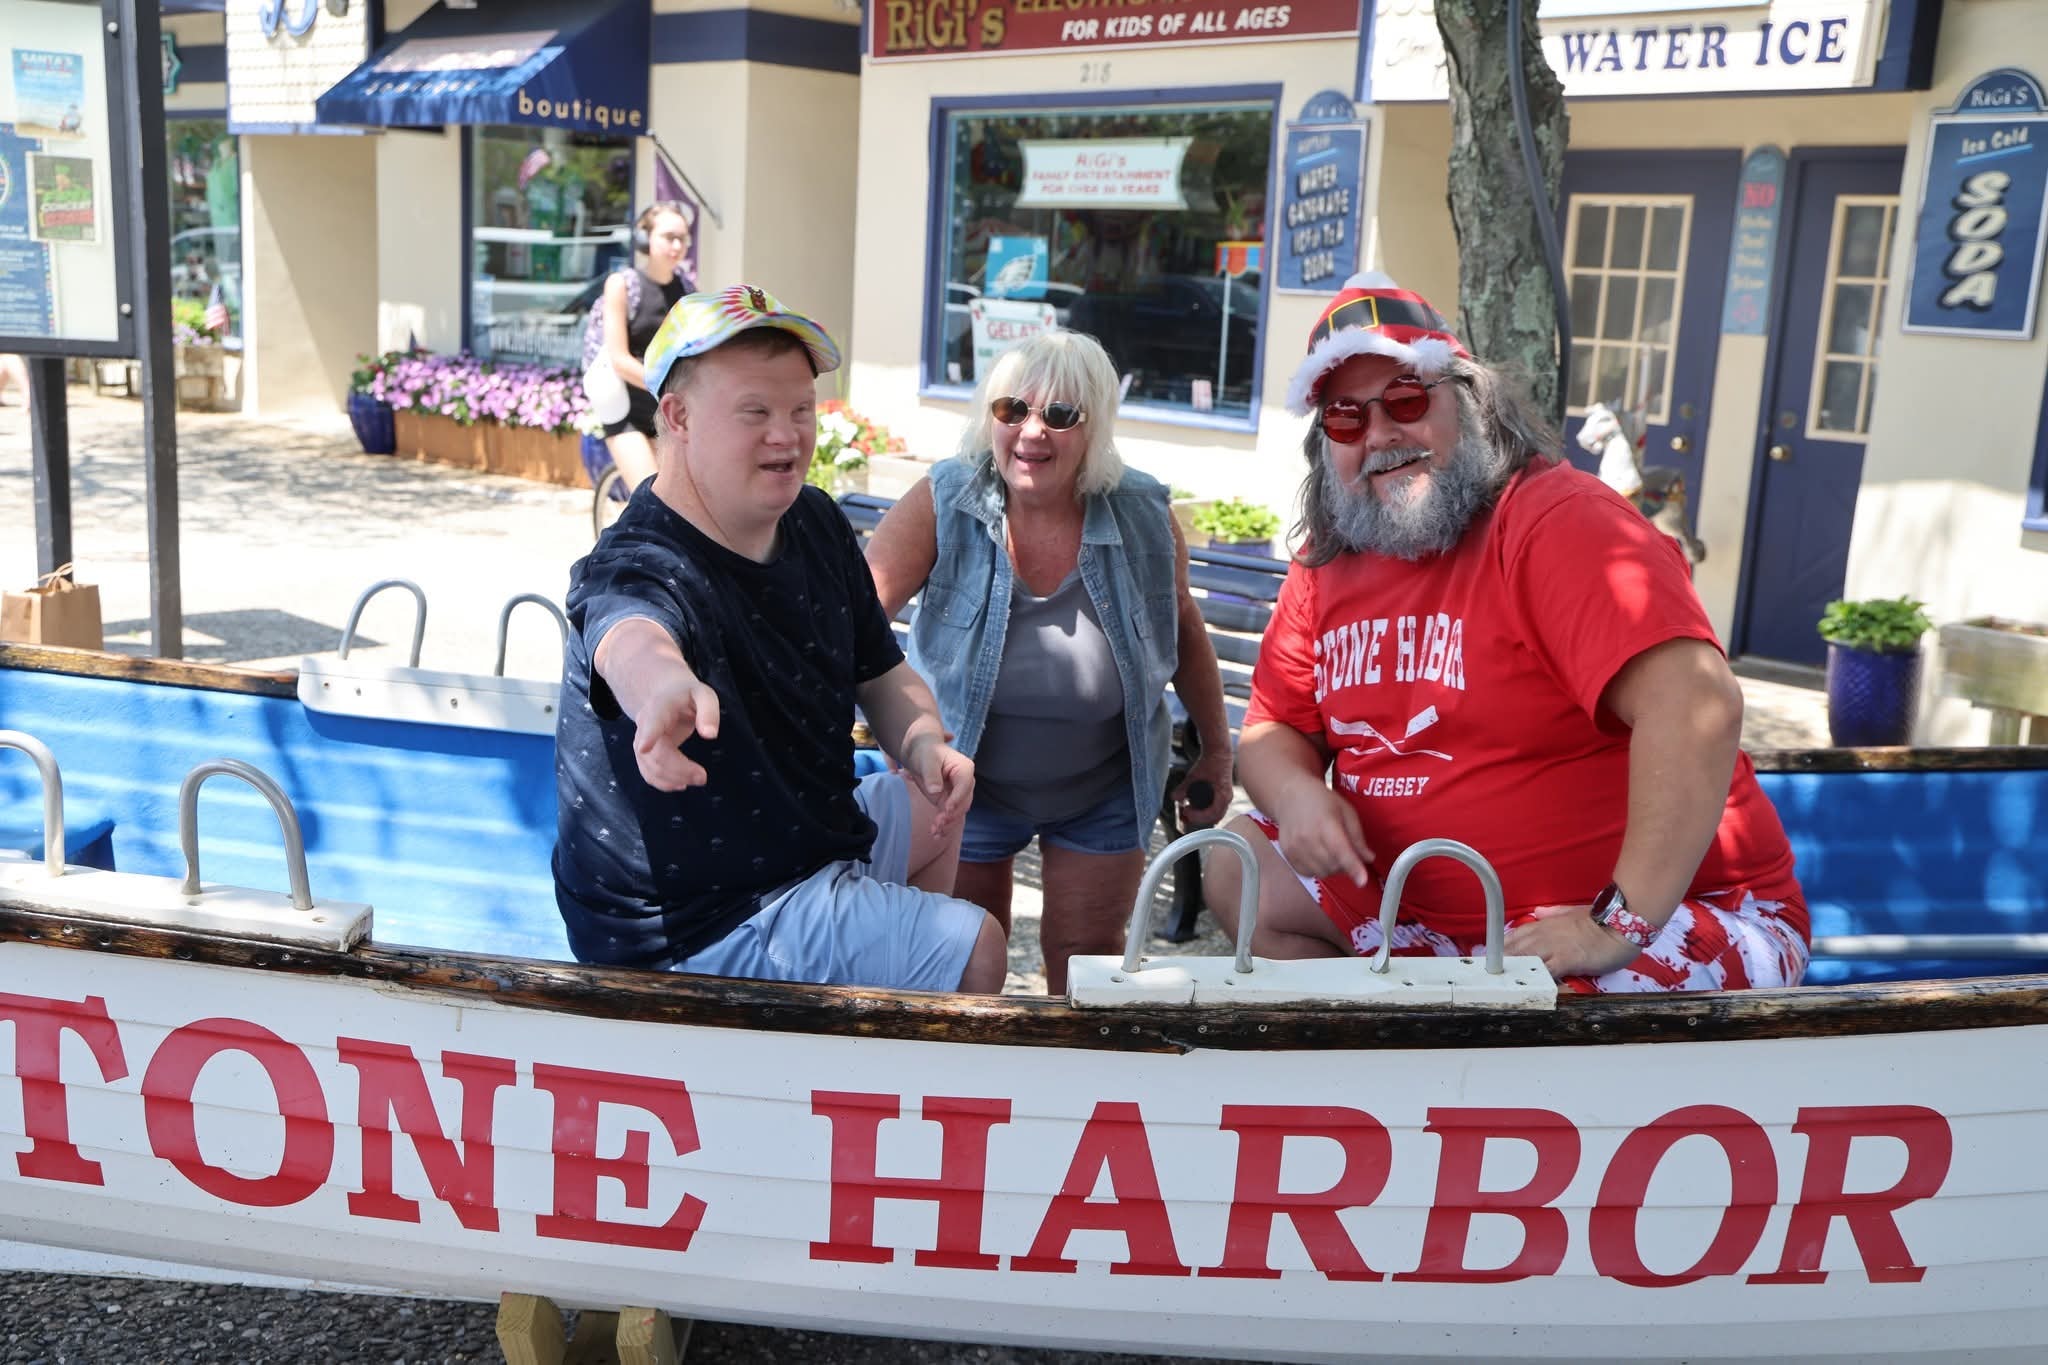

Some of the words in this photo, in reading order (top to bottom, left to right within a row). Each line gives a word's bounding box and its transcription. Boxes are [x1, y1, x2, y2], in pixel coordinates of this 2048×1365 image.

[885, 0, 1005, 50] RiGi's
[1061, 20, 1099, 41] FOR
[1104, 15, 1153, 38] KIDS
[1158, 13, 1187, 35] OF
[1189, 10, 1227, 33] ALL
[1234, 7, 1291, 31] AGES
[1562, 24, 1728, 73] WATER
[1754, 17, 1850, 67] ICE
[518, 88, 642, 129] boutique
[1962, 138, 1987, 155] Ice
[1992, 126, 2030, 150] Cold
[1299, 164, 1338, 196] WATER
[1941, 169, 2012, 307] SODA
[1363, 776, 1430, 797] JERSEY
[809, 1089, 1953, 1288] HARBOR
